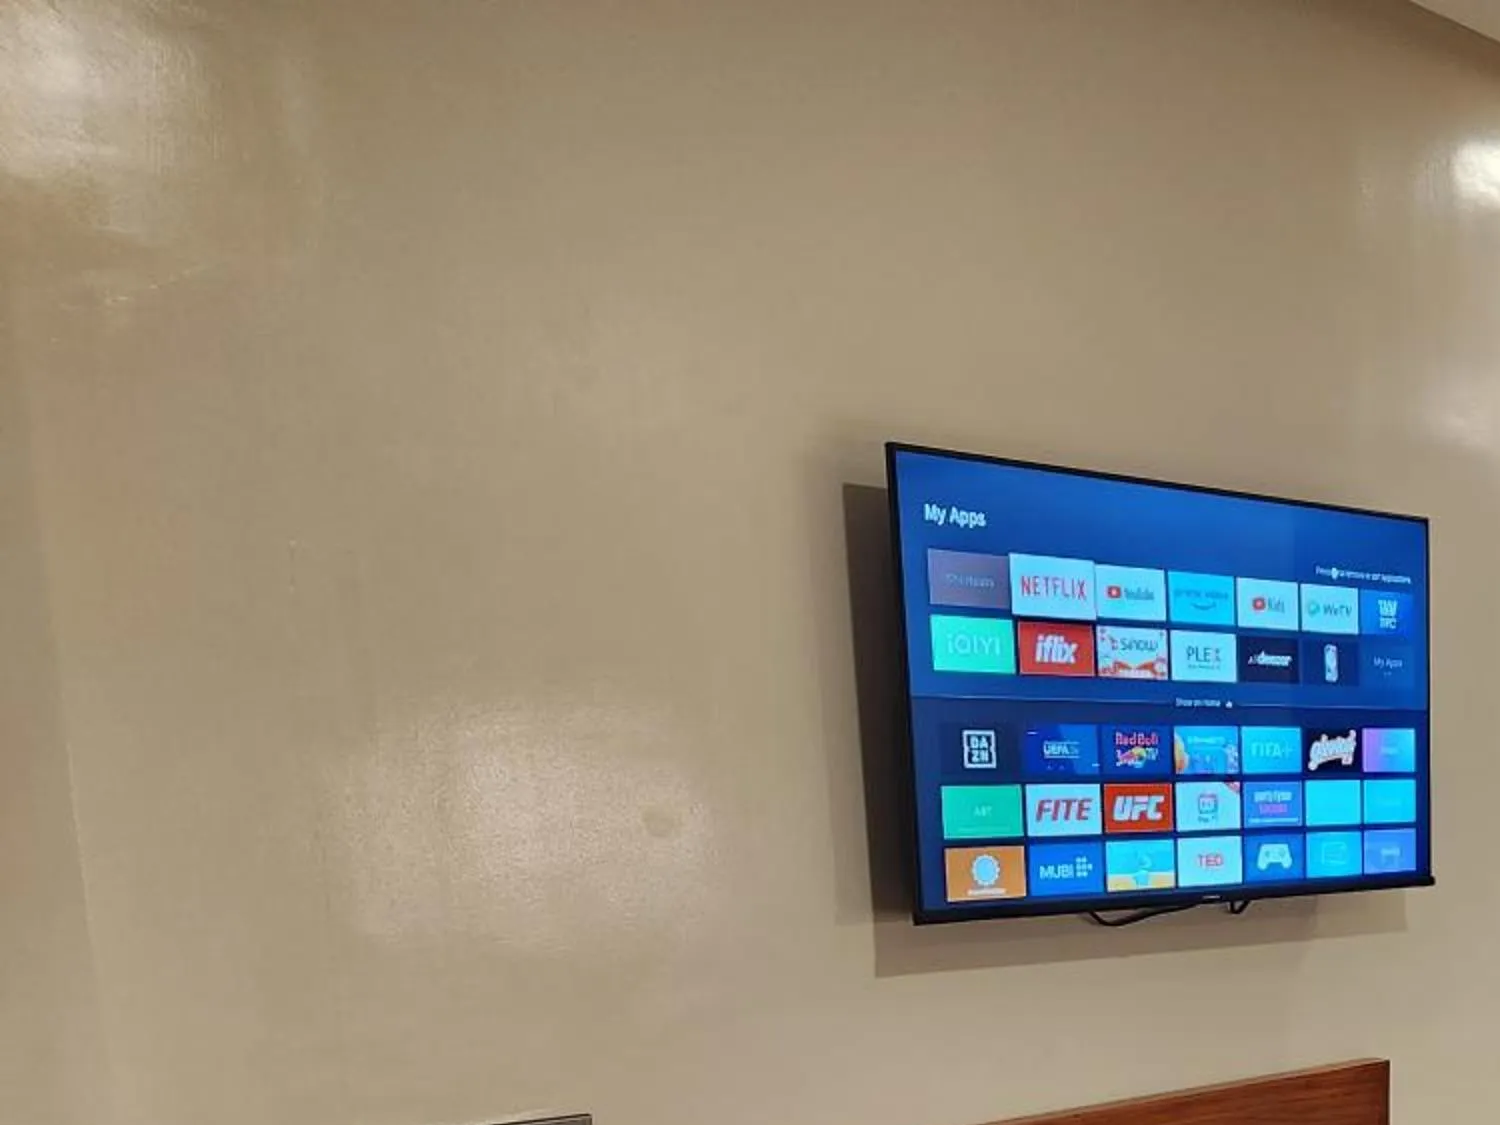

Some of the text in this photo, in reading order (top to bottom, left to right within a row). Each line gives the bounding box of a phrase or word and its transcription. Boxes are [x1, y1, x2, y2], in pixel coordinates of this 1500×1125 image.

[924, 503, 987, 528] My Apps
[1020, 575, 1088, 601] NETFLIX
[1035, 632, 1079, 664] iflix
[1185, 645, 1222, 663] PLEX
[1036, 798, 1094, 823] FITE
[1113, 795, 1165, 821] UFC
[1039, 864, 1075, 880] MUBI
[1197, 854, 1224, 867] TED
